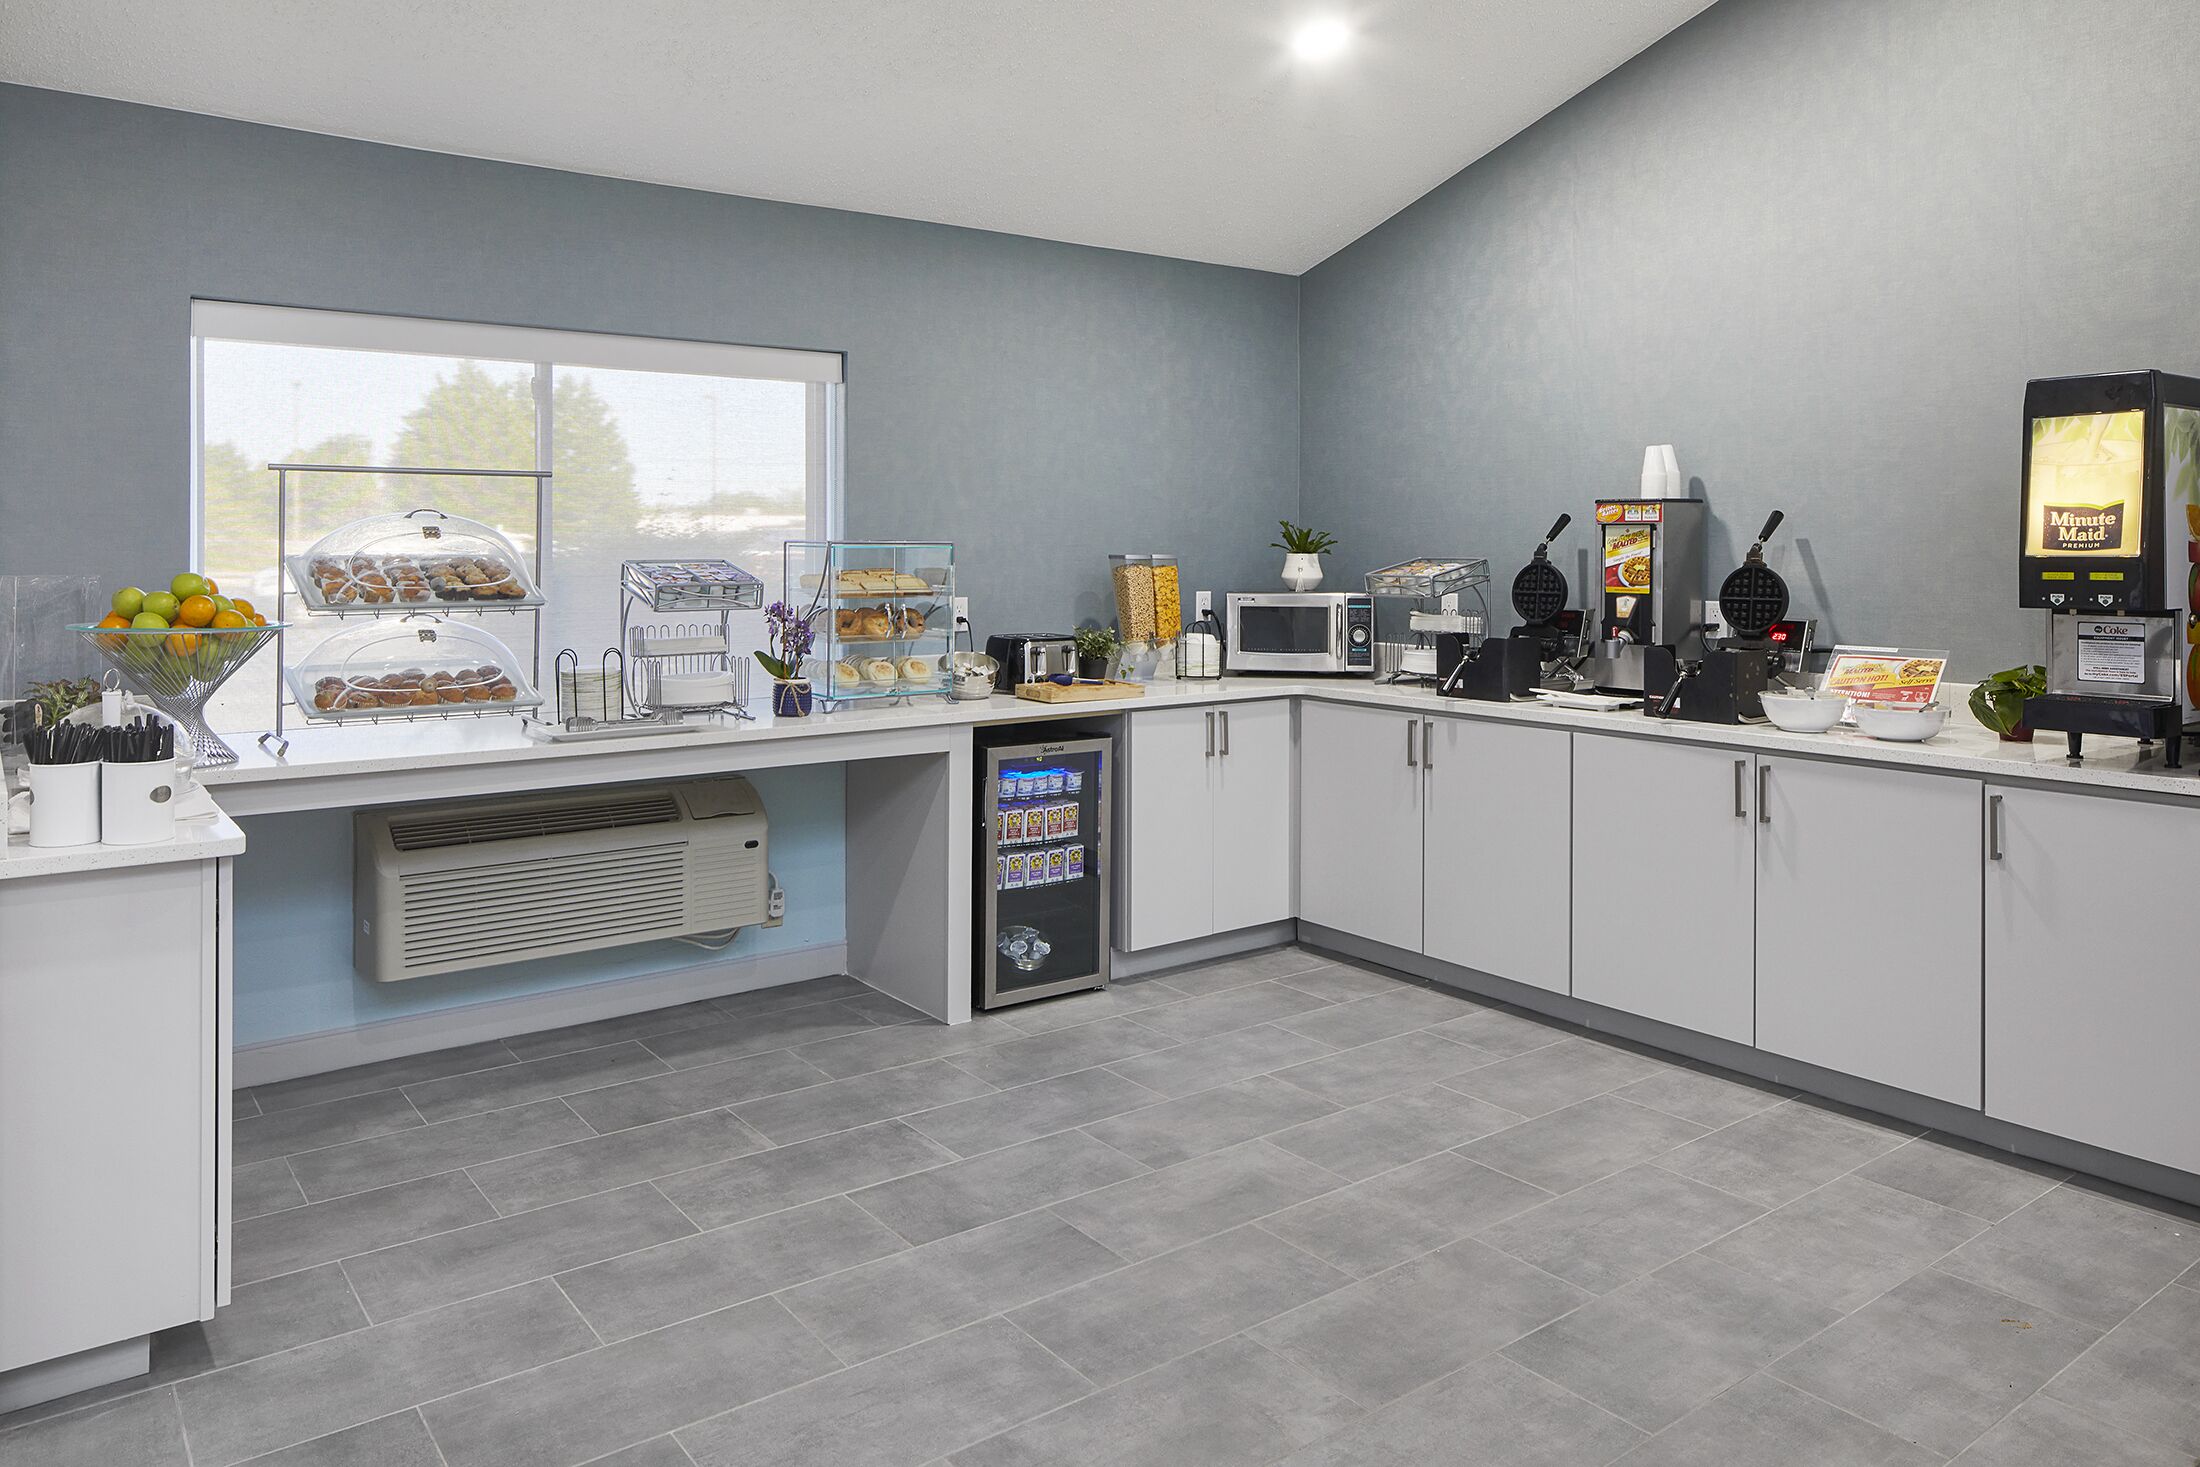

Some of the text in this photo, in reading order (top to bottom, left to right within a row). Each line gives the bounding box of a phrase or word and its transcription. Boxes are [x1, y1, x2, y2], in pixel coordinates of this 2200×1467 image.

[2050, 511, 2117, 527] Minute
[2058, 526, 2106, 541] Maid
[1612, 537, 1638, 550] MALTED
[2103, 625, 2128, 634] Coke
[1867, 674, 1889, 682] HOT!
[1914, 677, 1935, 685] Serve
